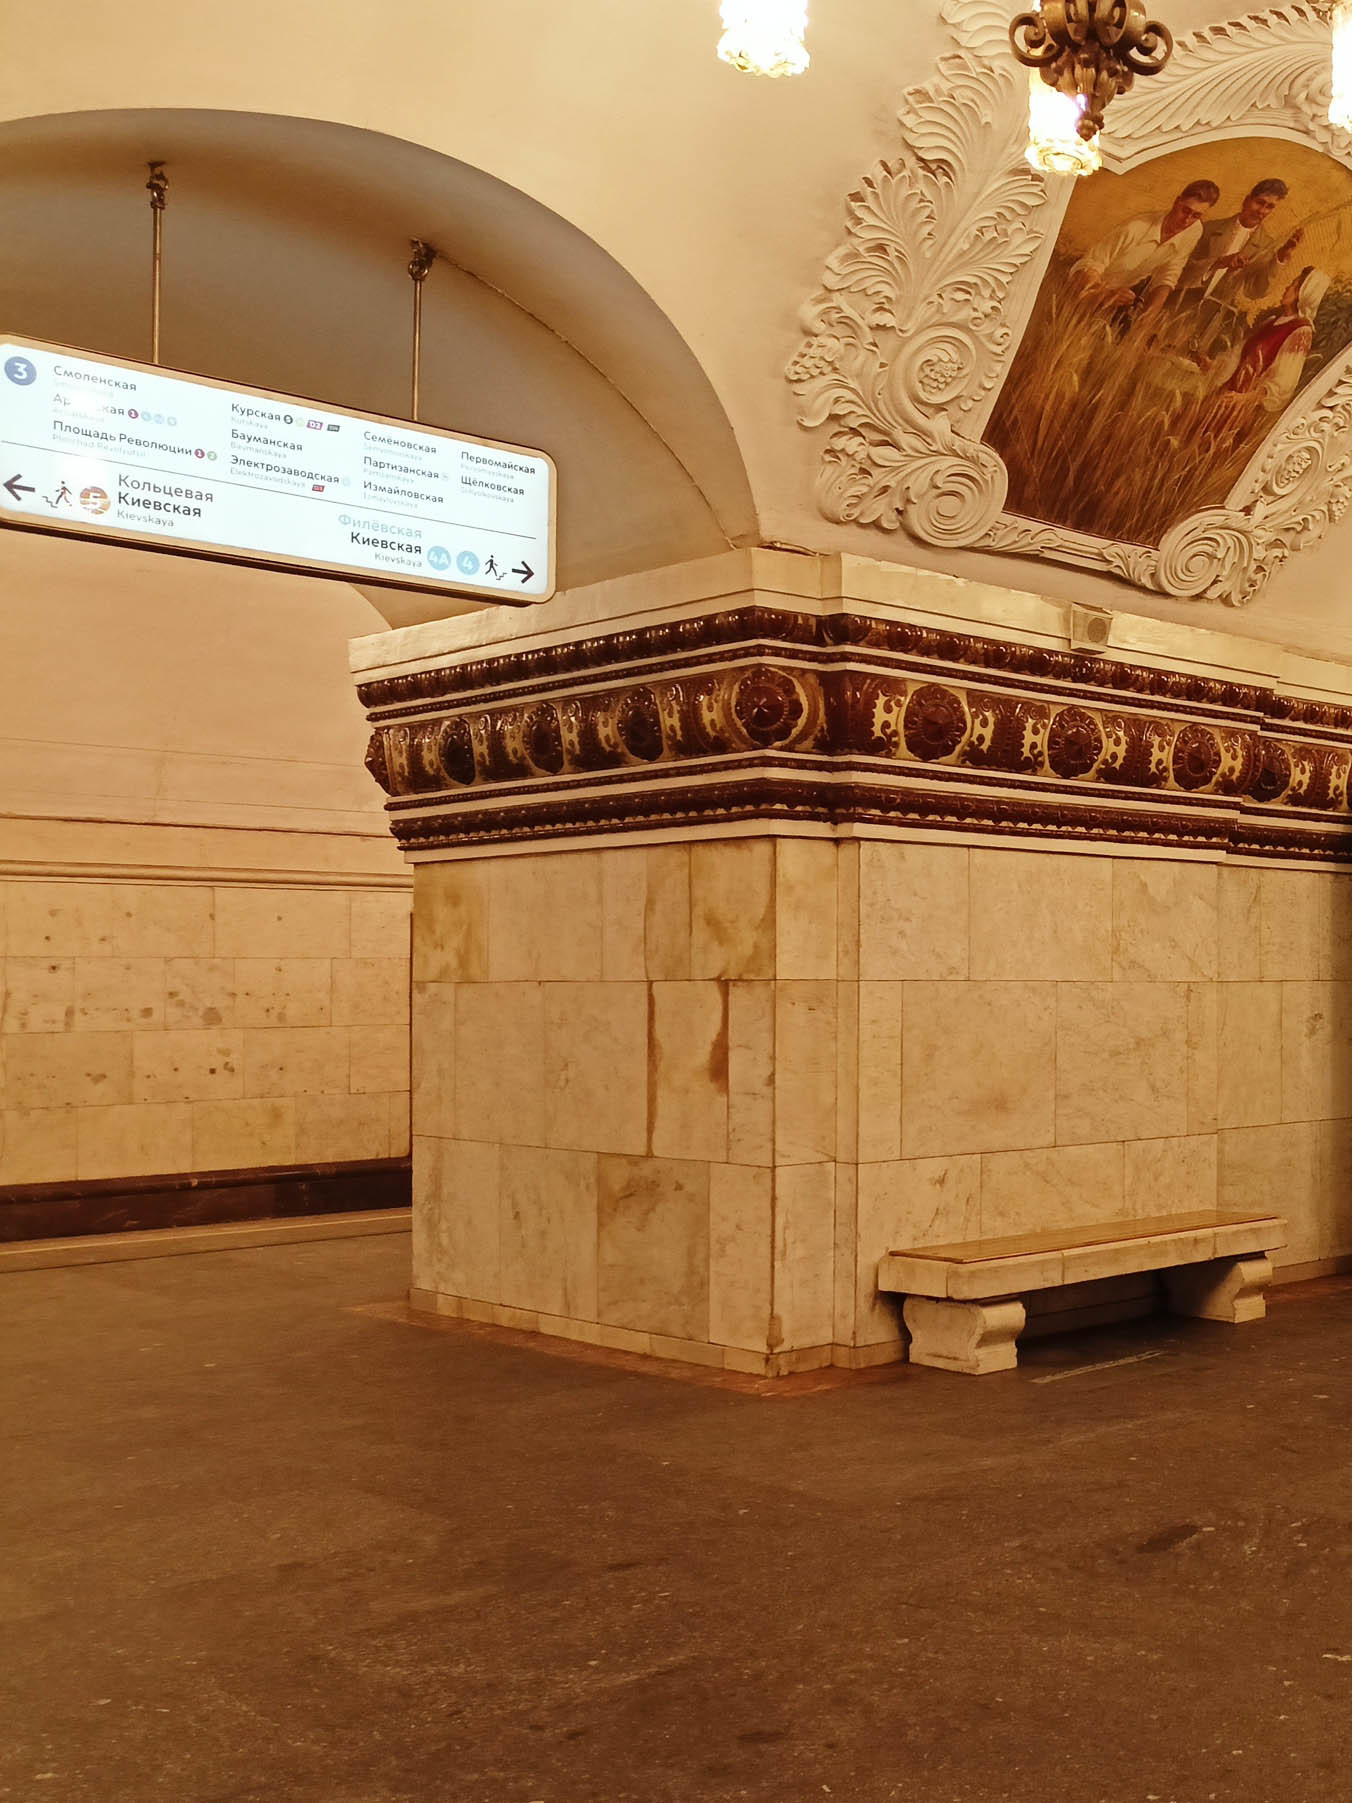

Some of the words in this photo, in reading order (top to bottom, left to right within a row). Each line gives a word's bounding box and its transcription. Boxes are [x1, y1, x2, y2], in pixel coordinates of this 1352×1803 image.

[53, 365, 137, 392] Смоленская
[231, 403, 281, 422] Курская
[53, 420, 117, 442] Площадь
[118, 433, 192, 456] Революции
[231, 428, 303, 451] Бауманская
[230, 454, 340, 484] Электрозаводская
[363, 456, 440, 479] Партизанская
[461, 450, 536, 475] Первомайская
[118, 474, 214, 502] Кольцевая
[363, 480, 444, 504] Измайловская
[460, 475, 525, 496] Щёлковская
[118, 491, 202, 518] Киевская
[117, 509, 175, 528] Kievskaya
[338, 514, 423, 540] Филёвская
[350, 531, 422, 555] Киевская
[374, 552, 423, 569] Kievskaya
